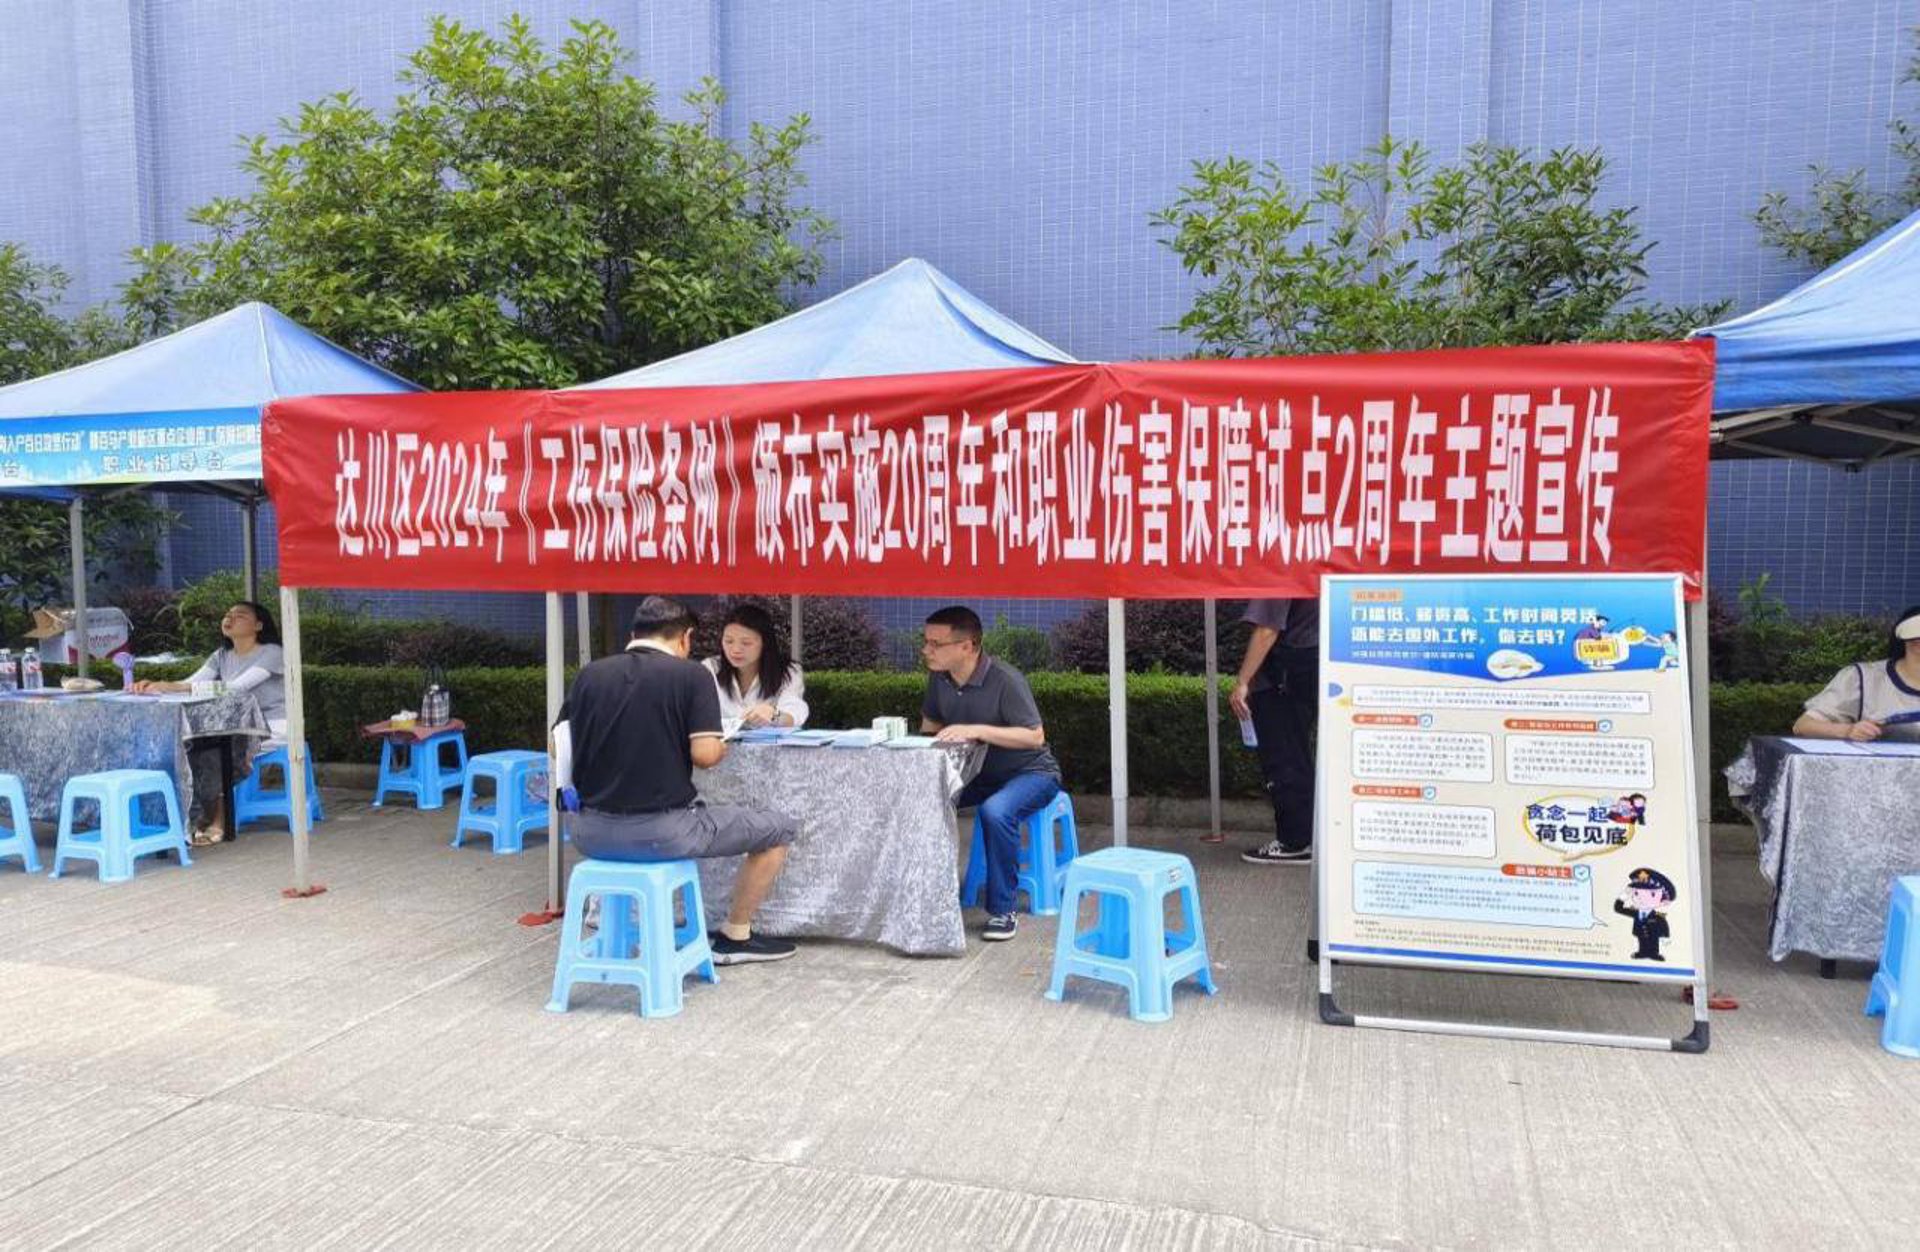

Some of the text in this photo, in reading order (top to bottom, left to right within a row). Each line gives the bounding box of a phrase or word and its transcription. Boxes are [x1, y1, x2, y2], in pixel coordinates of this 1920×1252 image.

[336, 386, 1620, 566] 达川区2024年《工伤保险条例》颁布实施20周年和职业伤害保障试点2周年主题宣传
[1526, 803, 1609, 823] 贪念一起
[1535, 824, 1628, 846] 荷包见底
